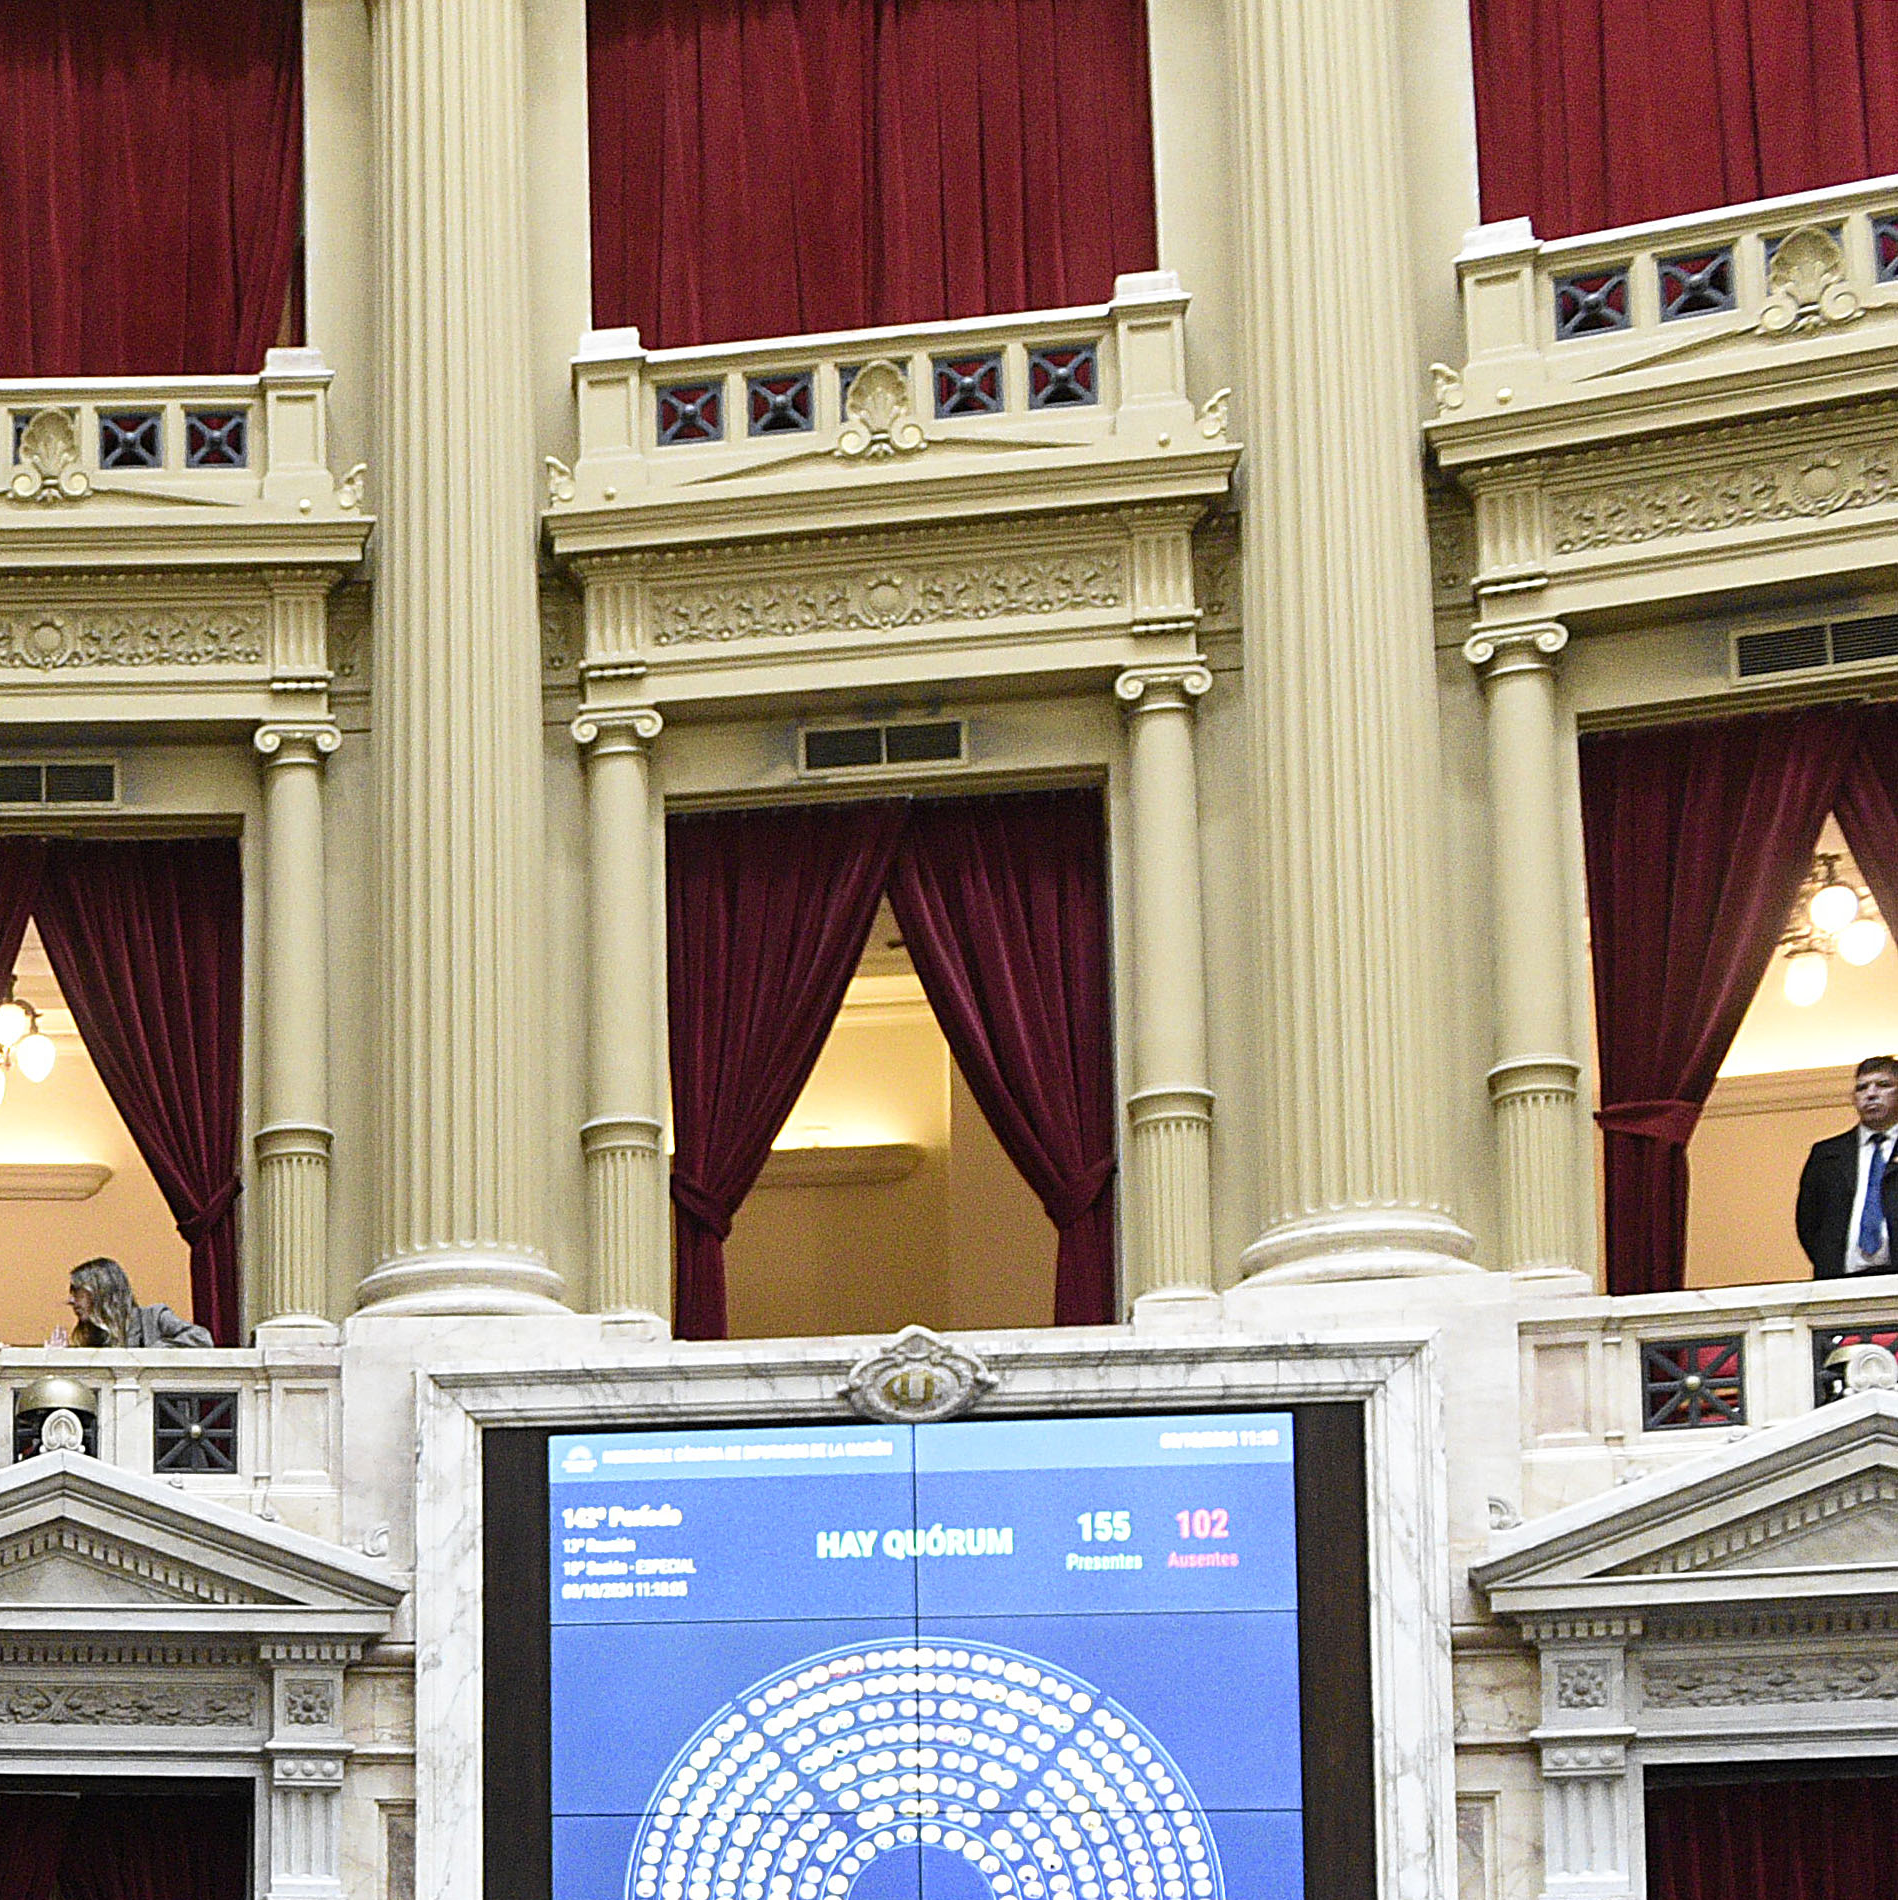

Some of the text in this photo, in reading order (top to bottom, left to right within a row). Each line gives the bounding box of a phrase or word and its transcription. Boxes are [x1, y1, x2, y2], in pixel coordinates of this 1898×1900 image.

[1076, 1508, 1229, 1542] 155 102
[817, 1523, 1013, 1560] HAY QUÓRUM
[1066, 1552, 1144, 1571] Presentes
[1168, 1550, 1239, 1569] Ausentes
